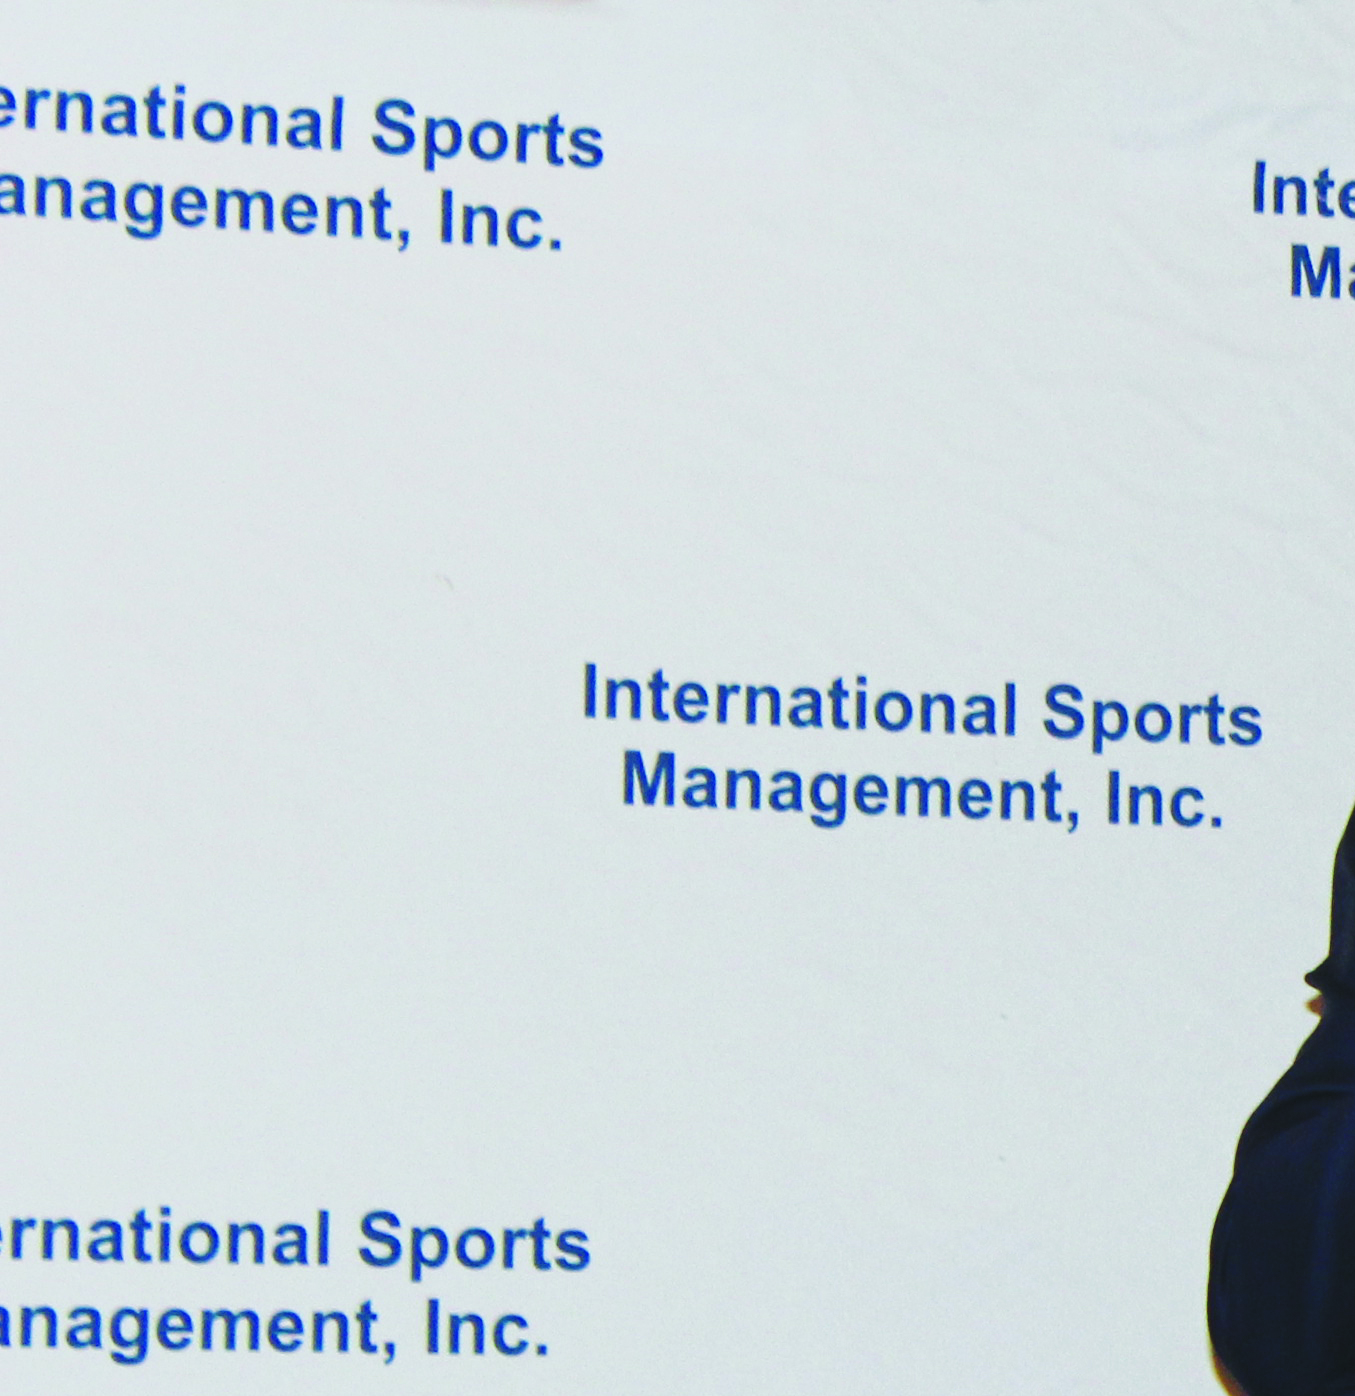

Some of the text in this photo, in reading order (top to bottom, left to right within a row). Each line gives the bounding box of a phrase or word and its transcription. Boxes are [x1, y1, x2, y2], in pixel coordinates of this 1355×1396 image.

[372, 98, 604, 173] Sports
[0, 172, 562, 252] anagement, Inc.
[584, 662, 1263, 755] International Sports
[623, 749, 1223, 834] Management, Inc.
[0, 1205, 591, 1283] rnational Sports
[0, 1297, 549, 1366] nagement, Inc.
